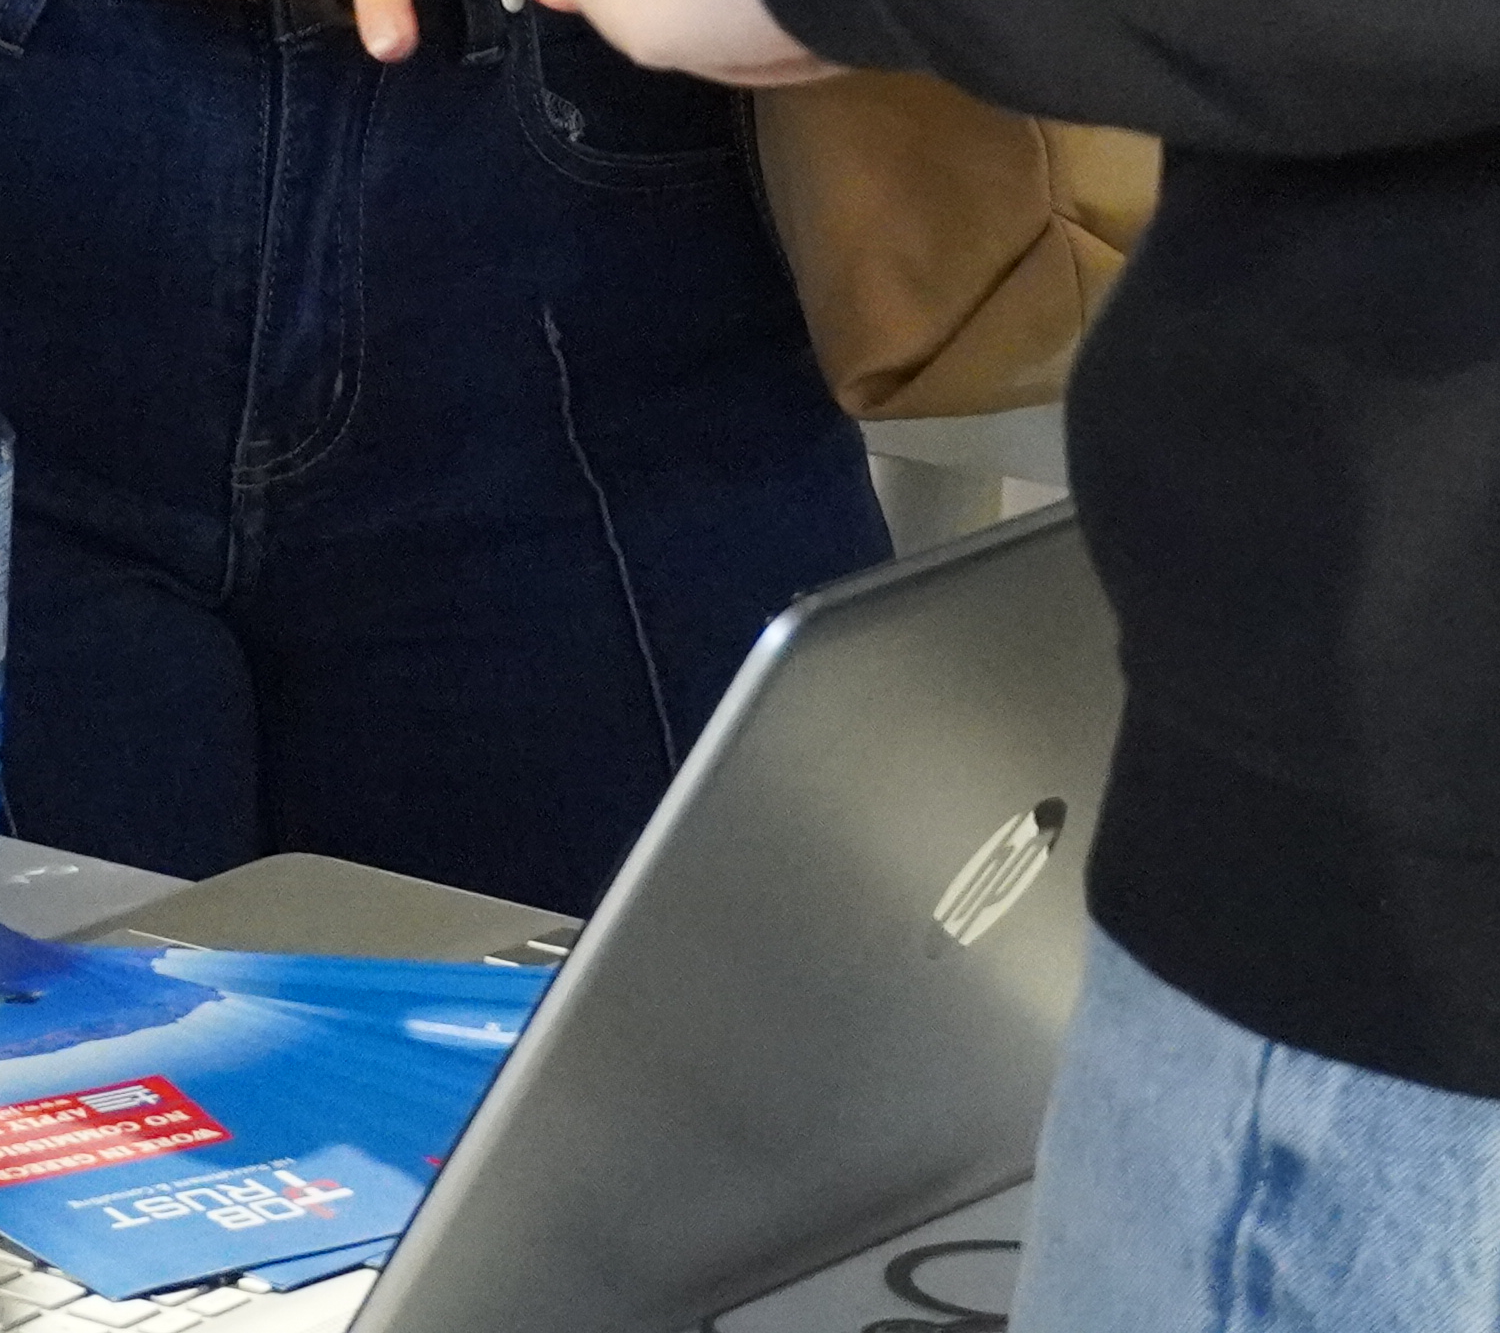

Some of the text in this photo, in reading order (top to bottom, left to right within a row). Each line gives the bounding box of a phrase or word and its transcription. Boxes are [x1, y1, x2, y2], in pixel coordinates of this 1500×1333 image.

[9, 1106, 89, 1134] APPLY
[143, 1109, 192, 1128] NO
[99, 1139, 132, 1160] IN
[132, 1127, 223, 1153] WORK
